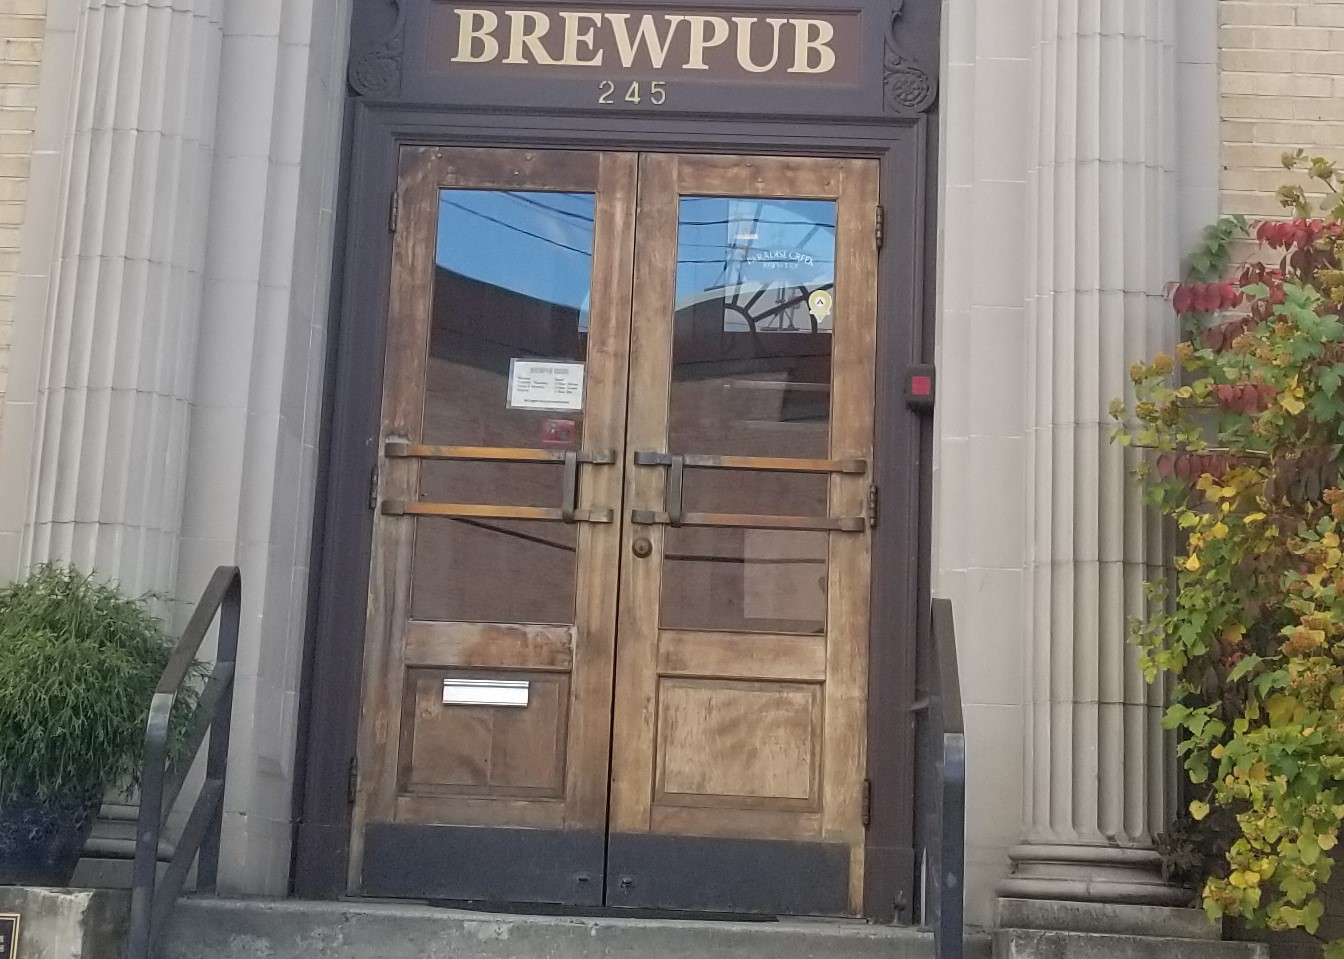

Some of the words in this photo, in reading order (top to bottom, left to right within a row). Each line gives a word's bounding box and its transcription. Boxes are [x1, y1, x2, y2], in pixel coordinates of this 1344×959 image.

[450, 8, 837, 74] BREWPUB
[597, 80, 668, 106] 245
[788, 250, 815, 267] CREEK
